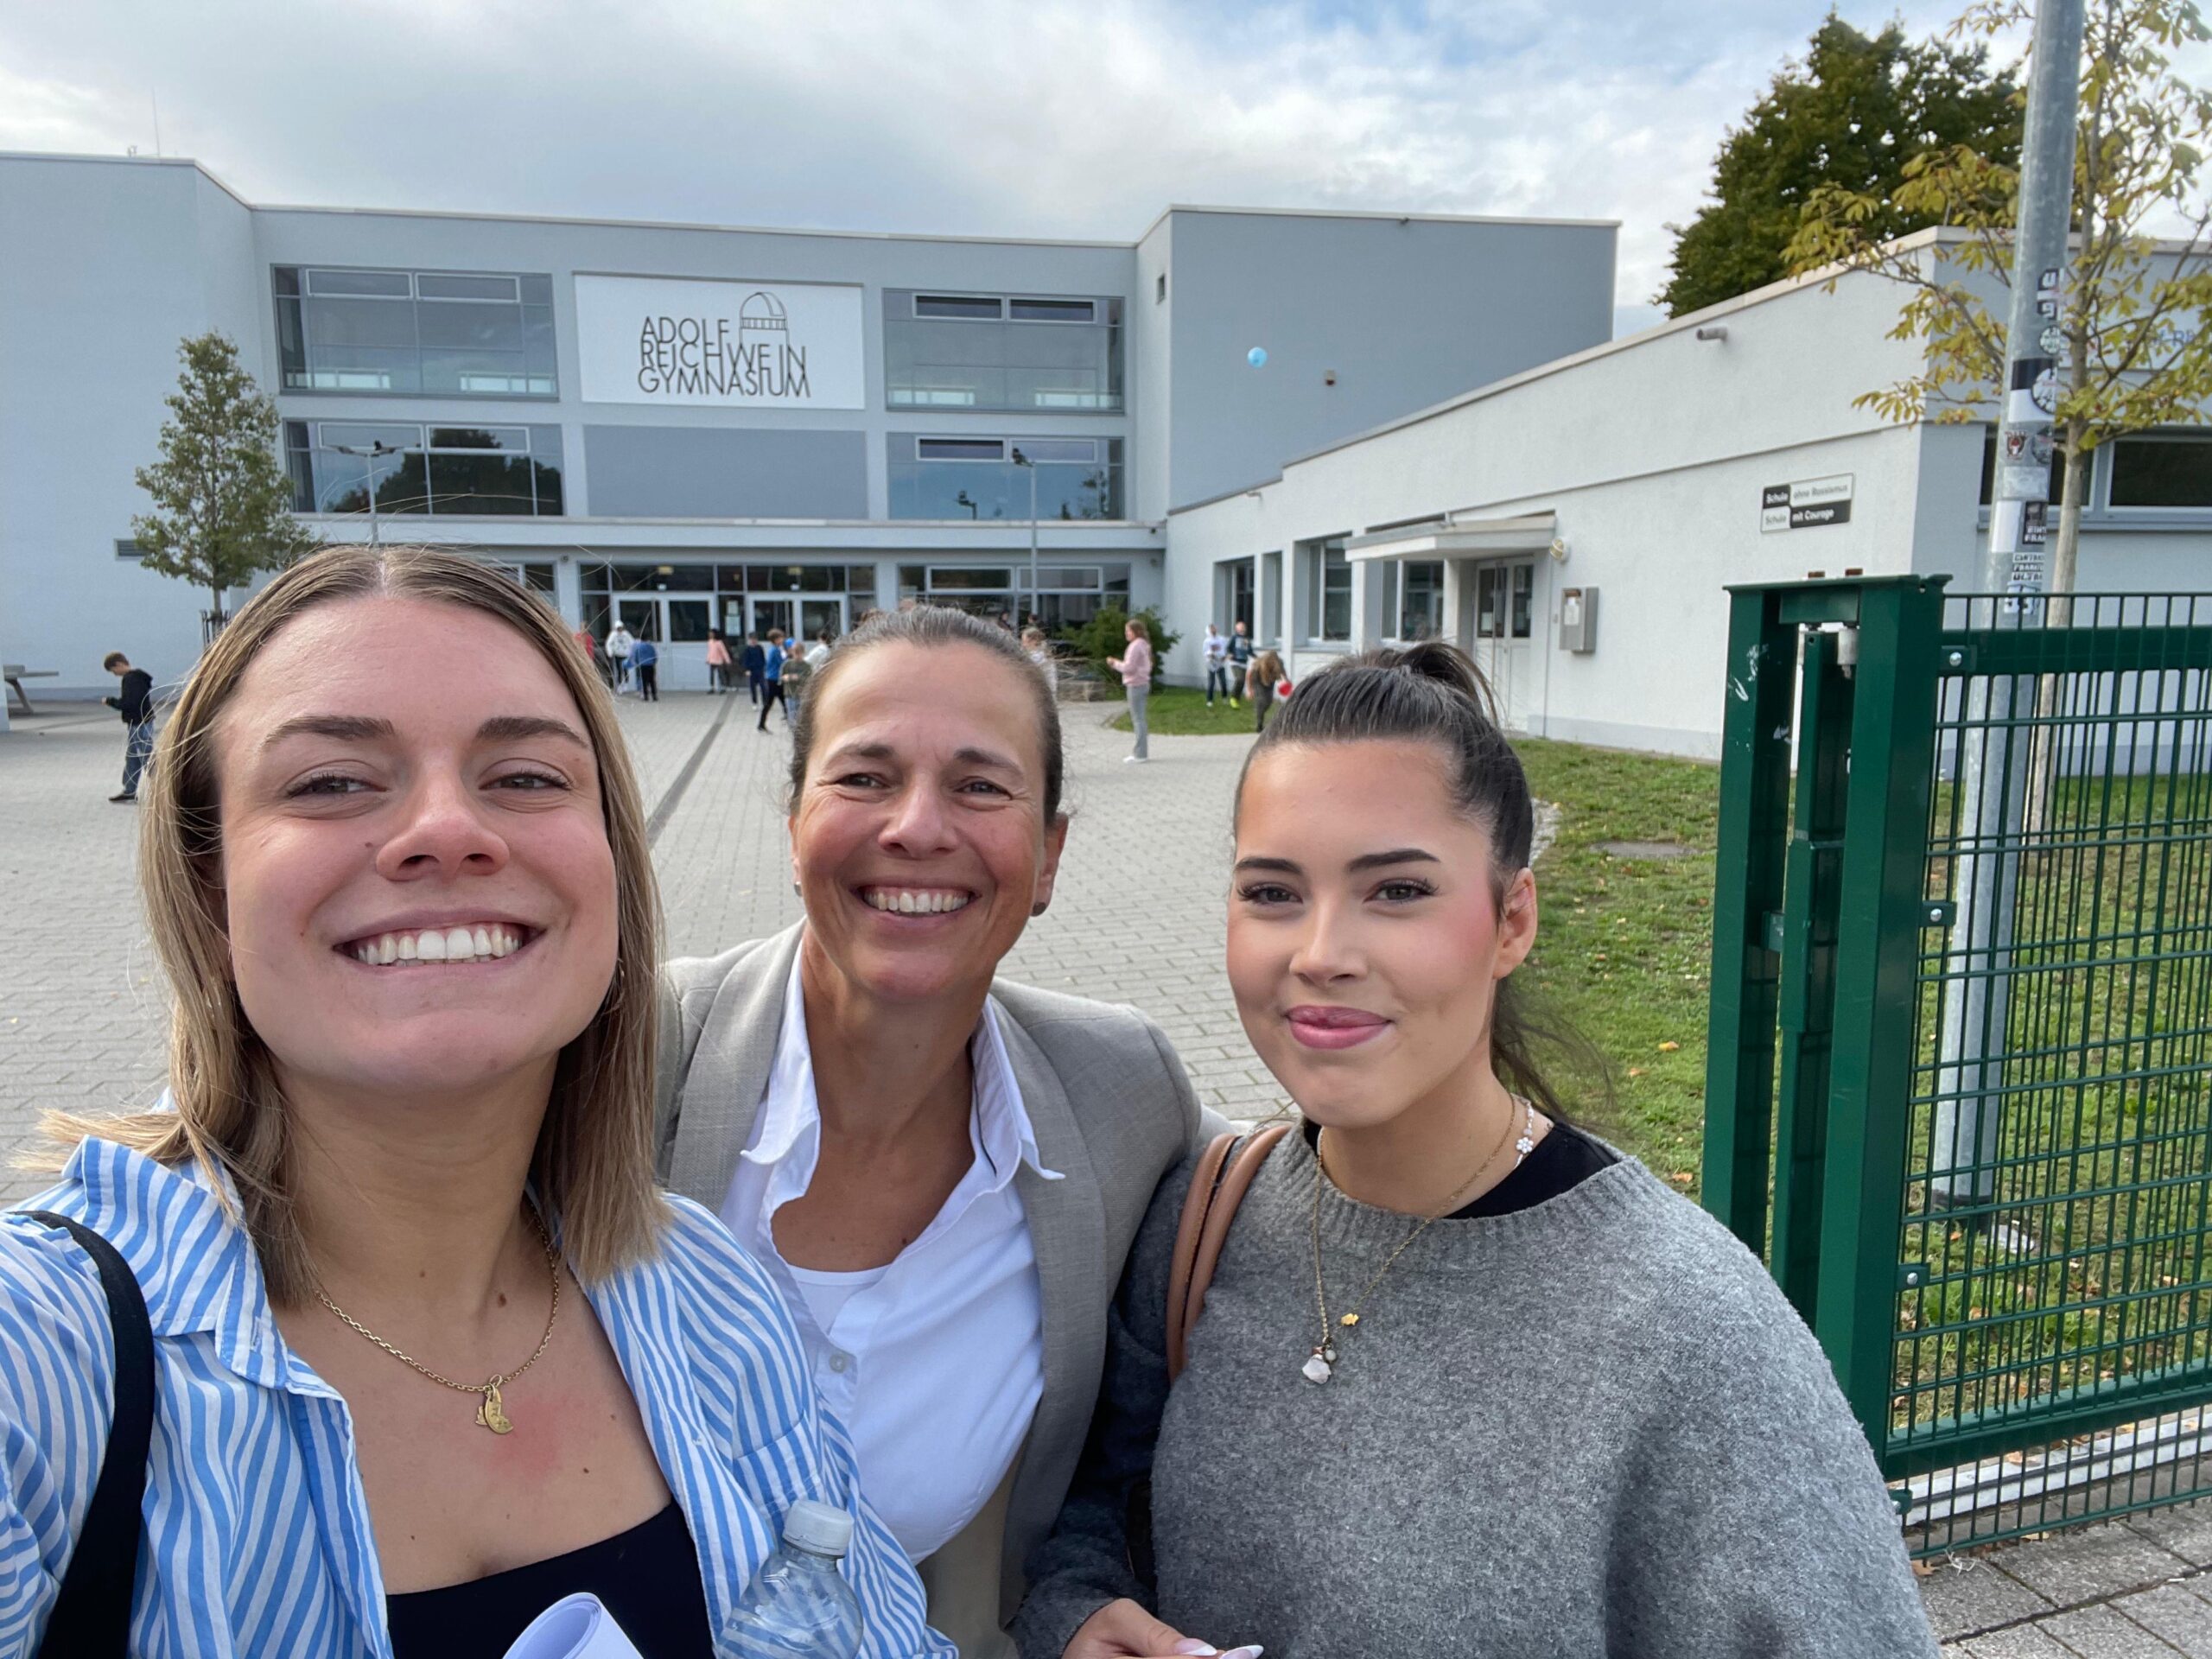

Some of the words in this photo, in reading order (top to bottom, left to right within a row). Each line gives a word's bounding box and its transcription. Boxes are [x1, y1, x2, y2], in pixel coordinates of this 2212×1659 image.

[641, 316, 730, 345] ADOLF
[641, 340, 806, 372] REICHWEIN
[638, 366, 811, 398] GYMNASIUM
